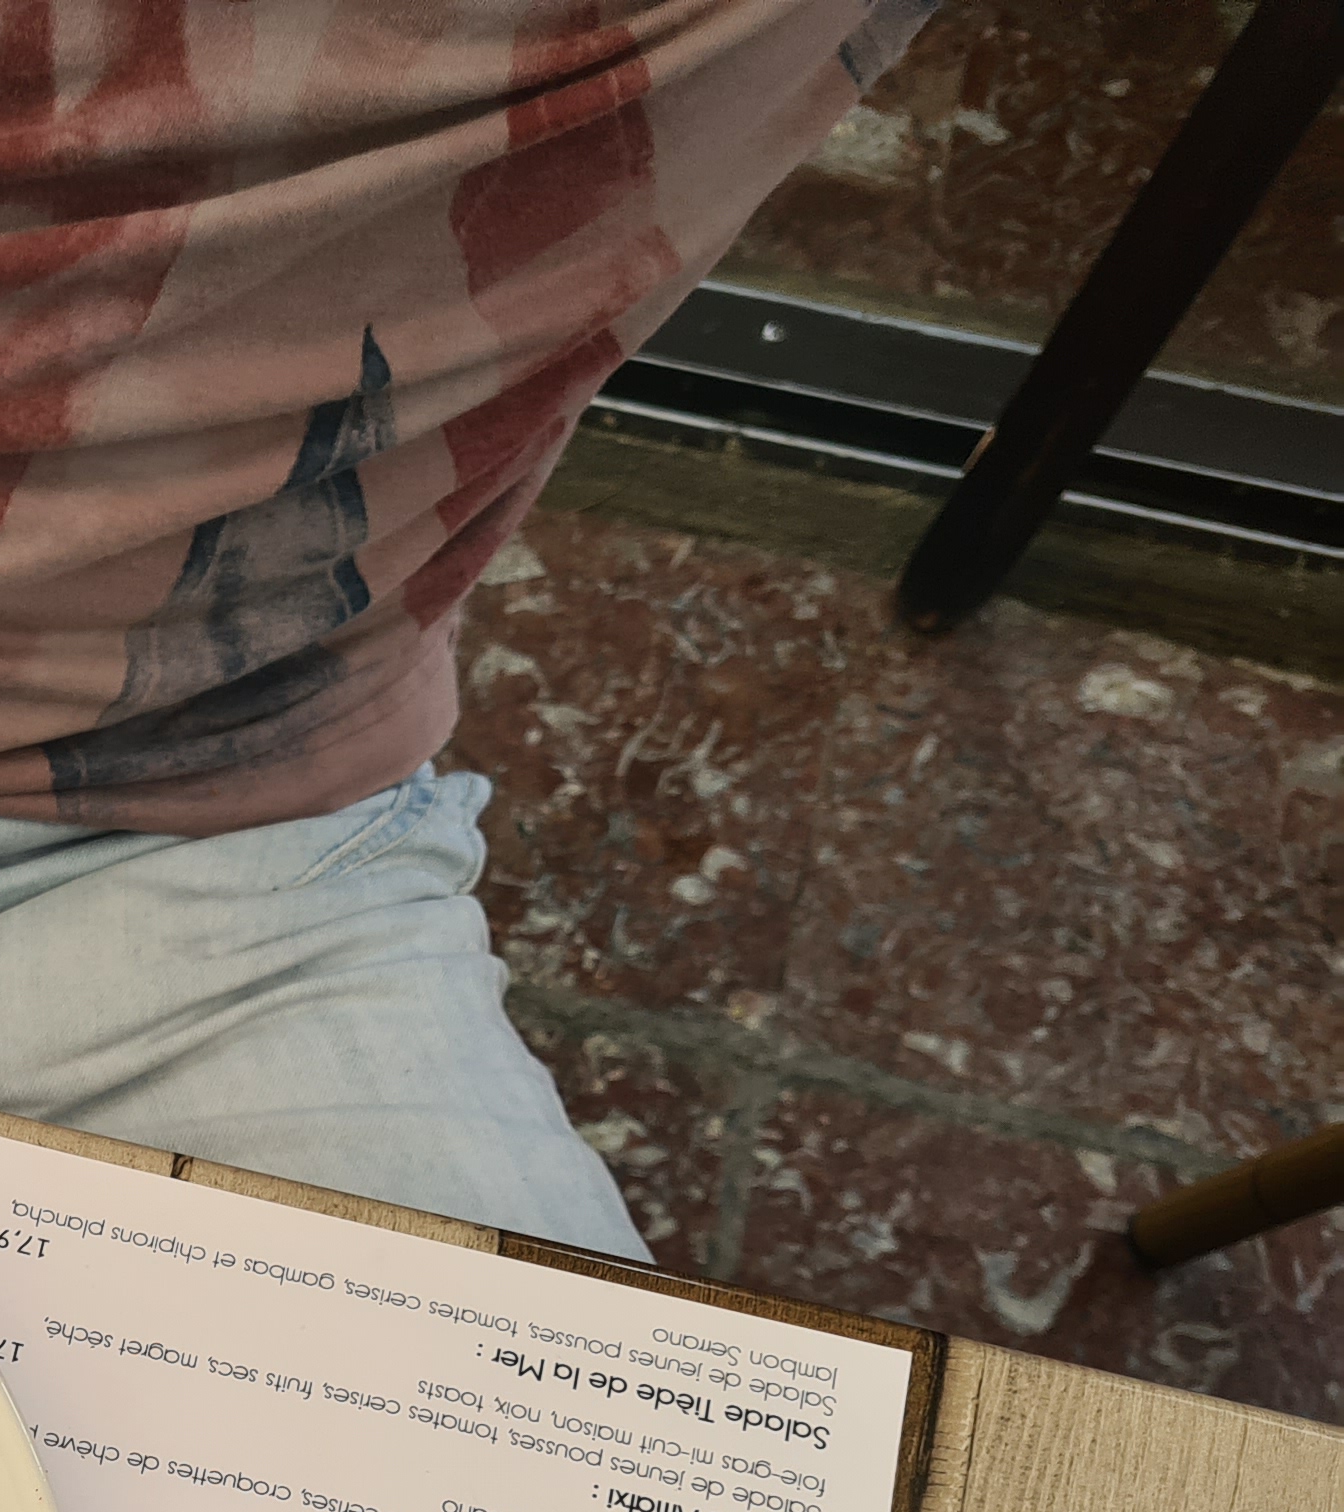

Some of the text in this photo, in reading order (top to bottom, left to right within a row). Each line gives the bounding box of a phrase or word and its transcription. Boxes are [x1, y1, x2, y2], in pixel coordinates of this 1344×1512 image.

[12, 1199, 837, 1417] Salade gambas chipirons plancha,
[44, 1317, 113, 1349] séché,
[118, 1338, 198, 1368] magret
[208, 1356, 258, 1382] secs,
[652, 1328, 838, 1390] Jambon Serrano
[266, 1372, 313, 1400] fruits
[491, 1348, 830, 1450] Salade Tiède Mer
[43, 1432, 120, 1465] chèvre
[494, 1396, 826, 1498] foie-gras mi-cuit maison, noix,
[167, 1461, 291, 1501] croquettes
